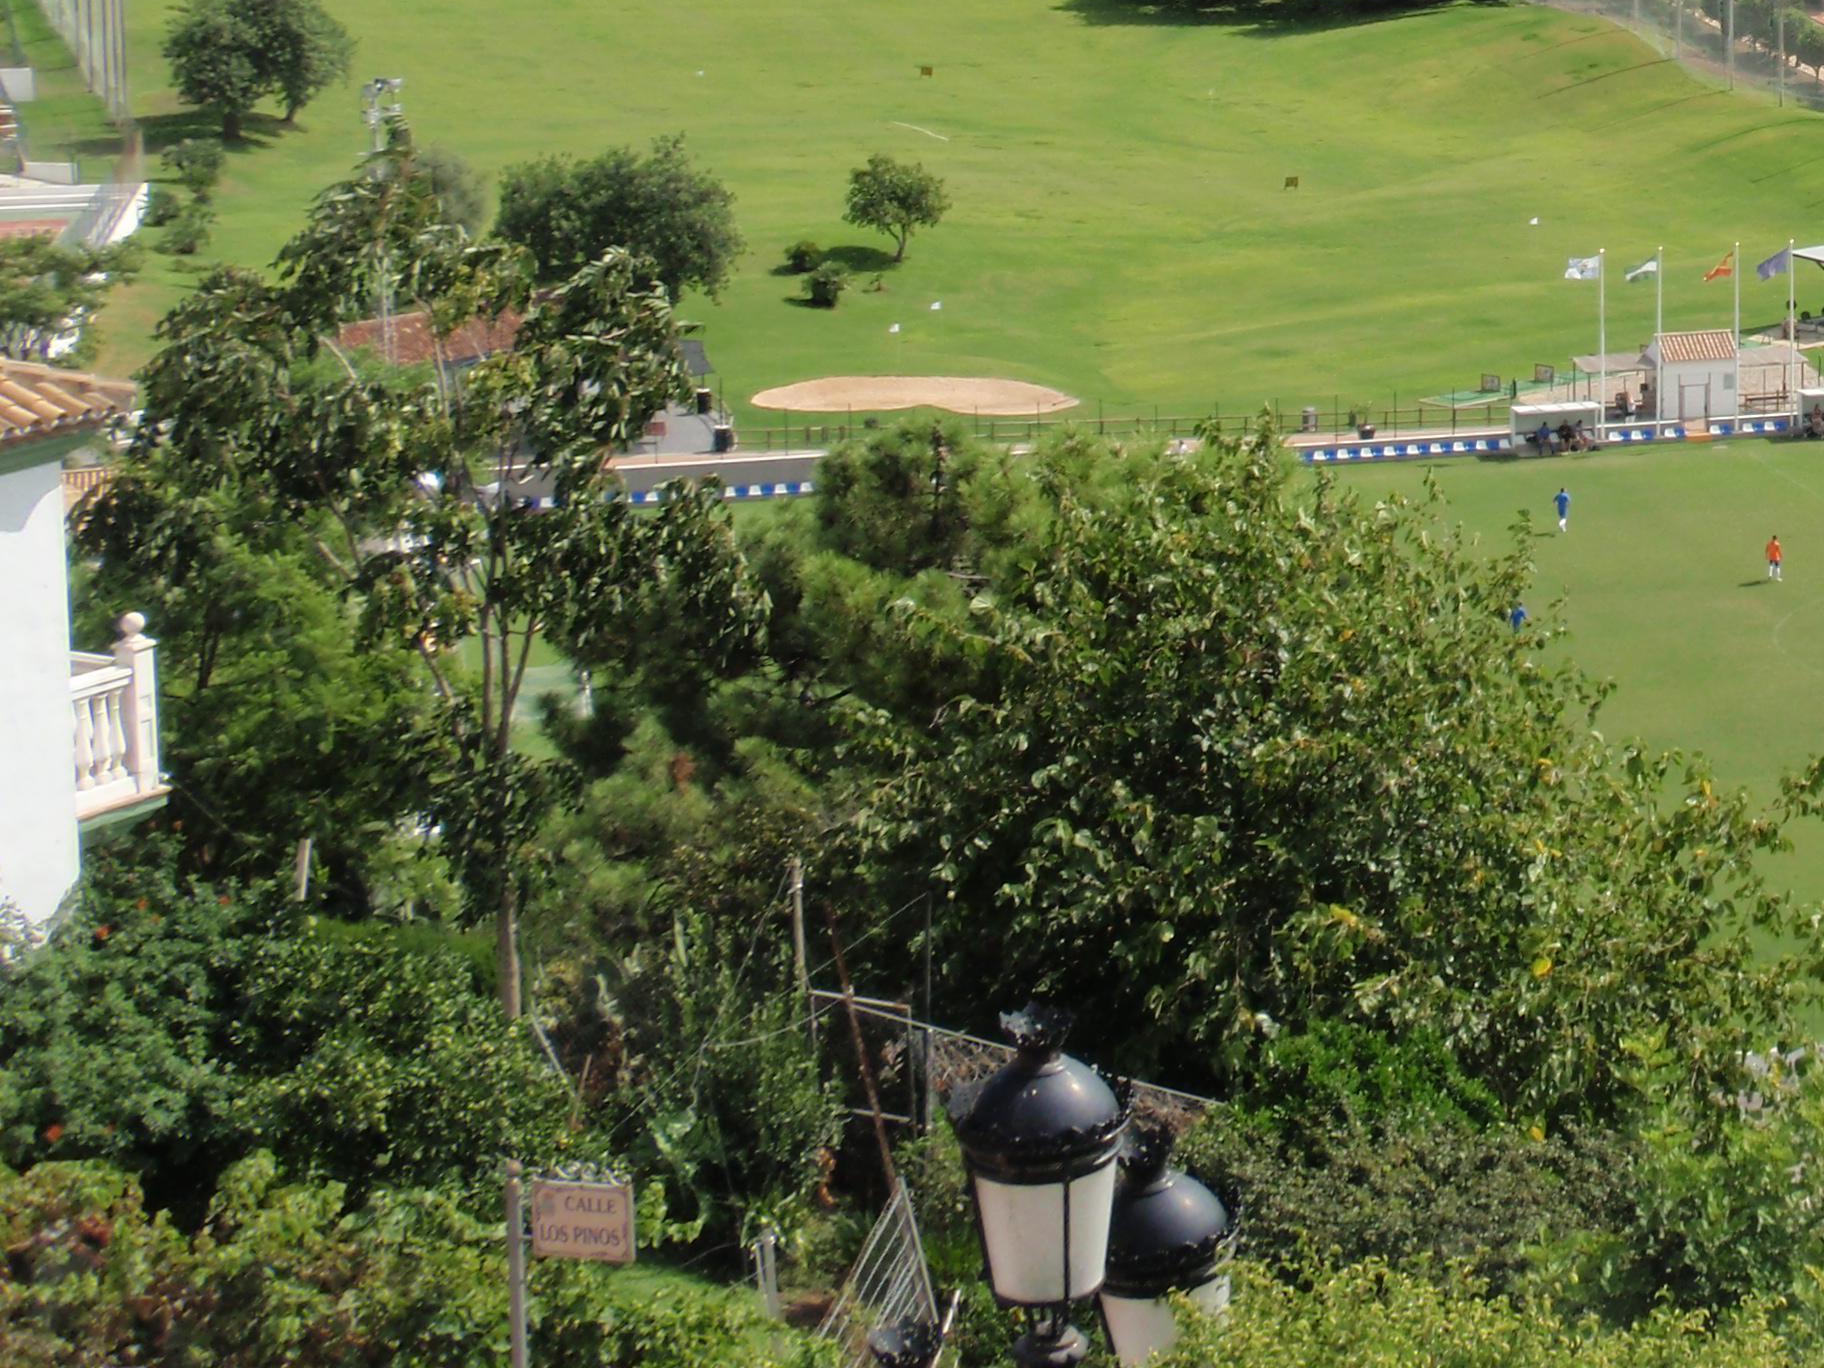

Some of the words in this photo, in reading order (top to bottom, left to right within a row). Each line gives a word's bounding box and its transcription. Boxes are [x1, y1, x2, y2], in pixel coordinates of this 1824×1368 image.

[564, 1195, 616, 1214] CALLE
[540, 1224, 568, 1243] LOS
[573, 1226, 620, 1246] PINOS
